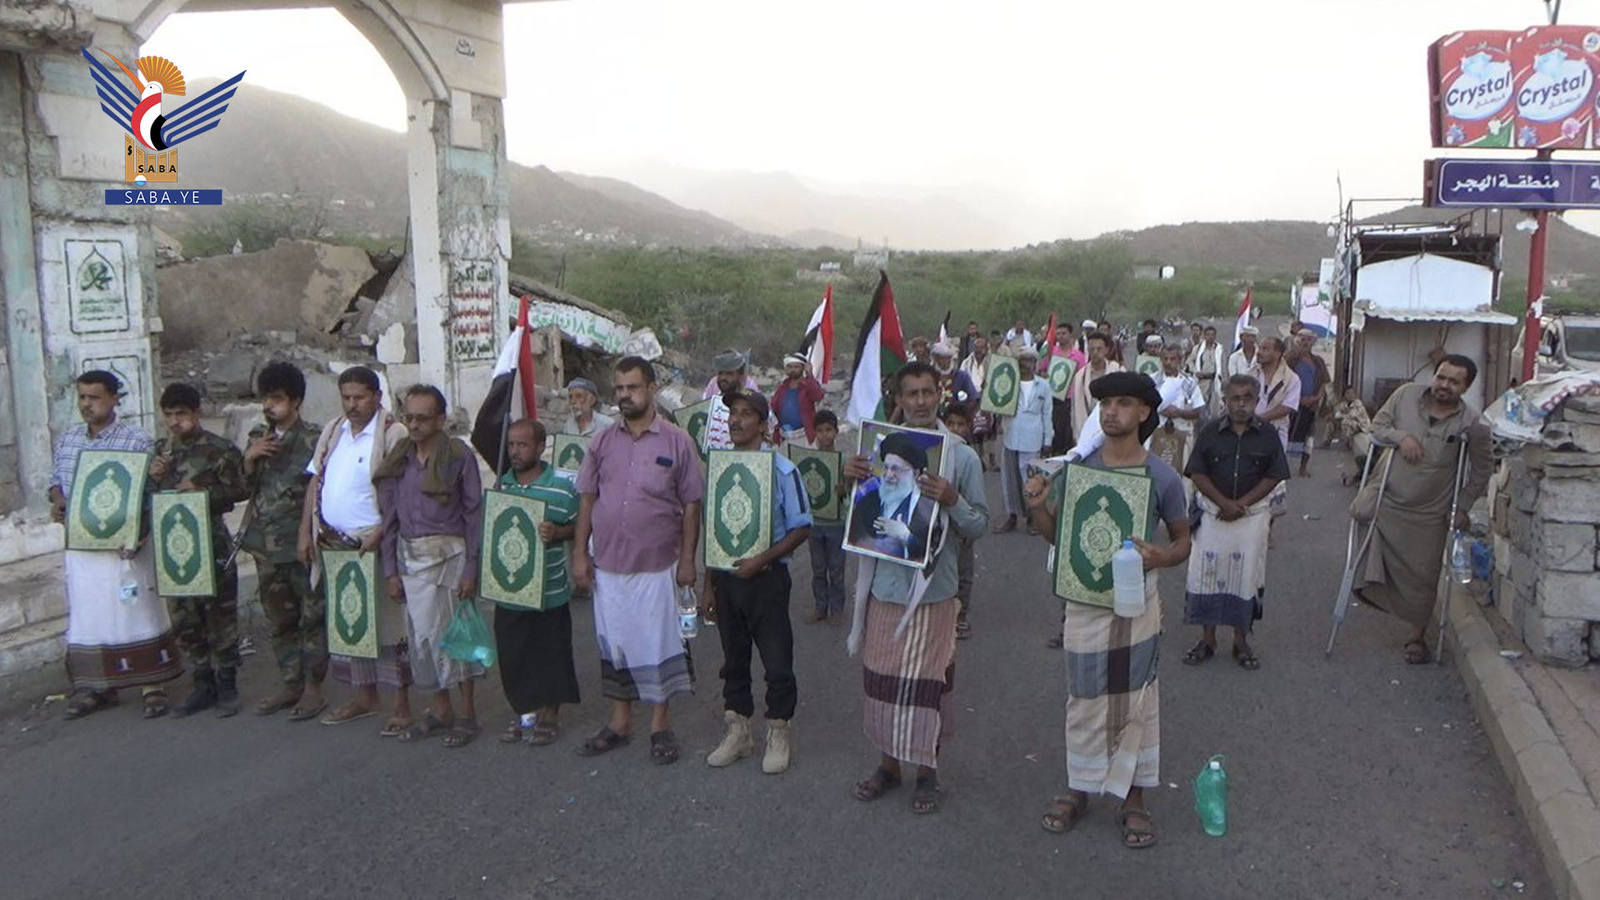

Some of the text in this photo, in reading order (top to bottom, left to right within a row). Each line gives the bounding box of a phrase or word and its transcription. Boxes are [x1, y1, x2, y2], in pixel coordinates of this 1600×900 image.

[1446, 71, 1510, 106] Crystal
[1518, 69, 1587, 107] Crystal
[1451, 174, 1497, 192] الهجر
